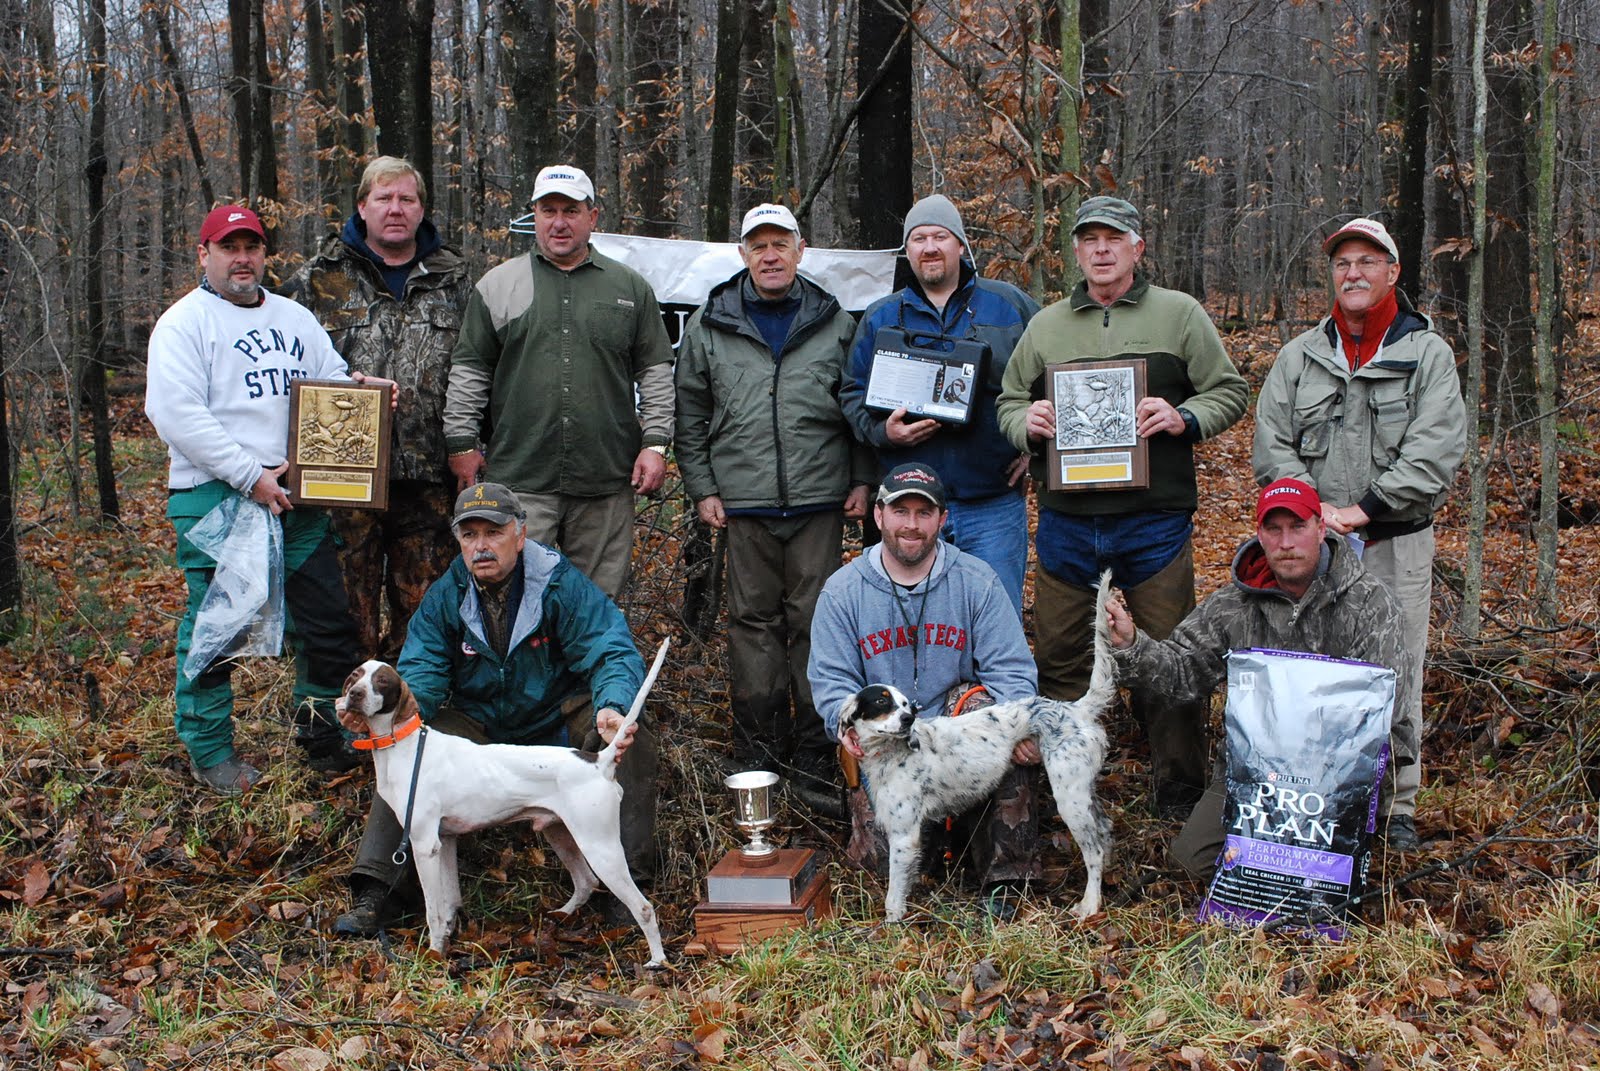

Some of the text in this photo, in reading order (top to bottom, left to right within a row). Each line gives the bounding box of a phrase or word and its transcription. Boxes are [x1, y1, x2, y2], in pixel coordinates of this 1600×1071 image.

[233, 328, 305, 363] PENN
[877, 350, 900, 358] CLASSIC
[244, 368, 307, 399] STA
[463, 500, 498, 509] BROWNING
[858, 623, 967, 660] TEXAS TECH
[1276, 774, 1312, 785] PURINA
[1251, 782, 1325, 816] PRO
[1233, 804, 1340, 846] PLAN
[1248, 851, 1303, 870] FORMULA
[1249, 841, 1334, 865] PERFORMANCE
[1244, 869, 1258, 877] REAL
[1260, 872, 1285, 881] CHICKEN
